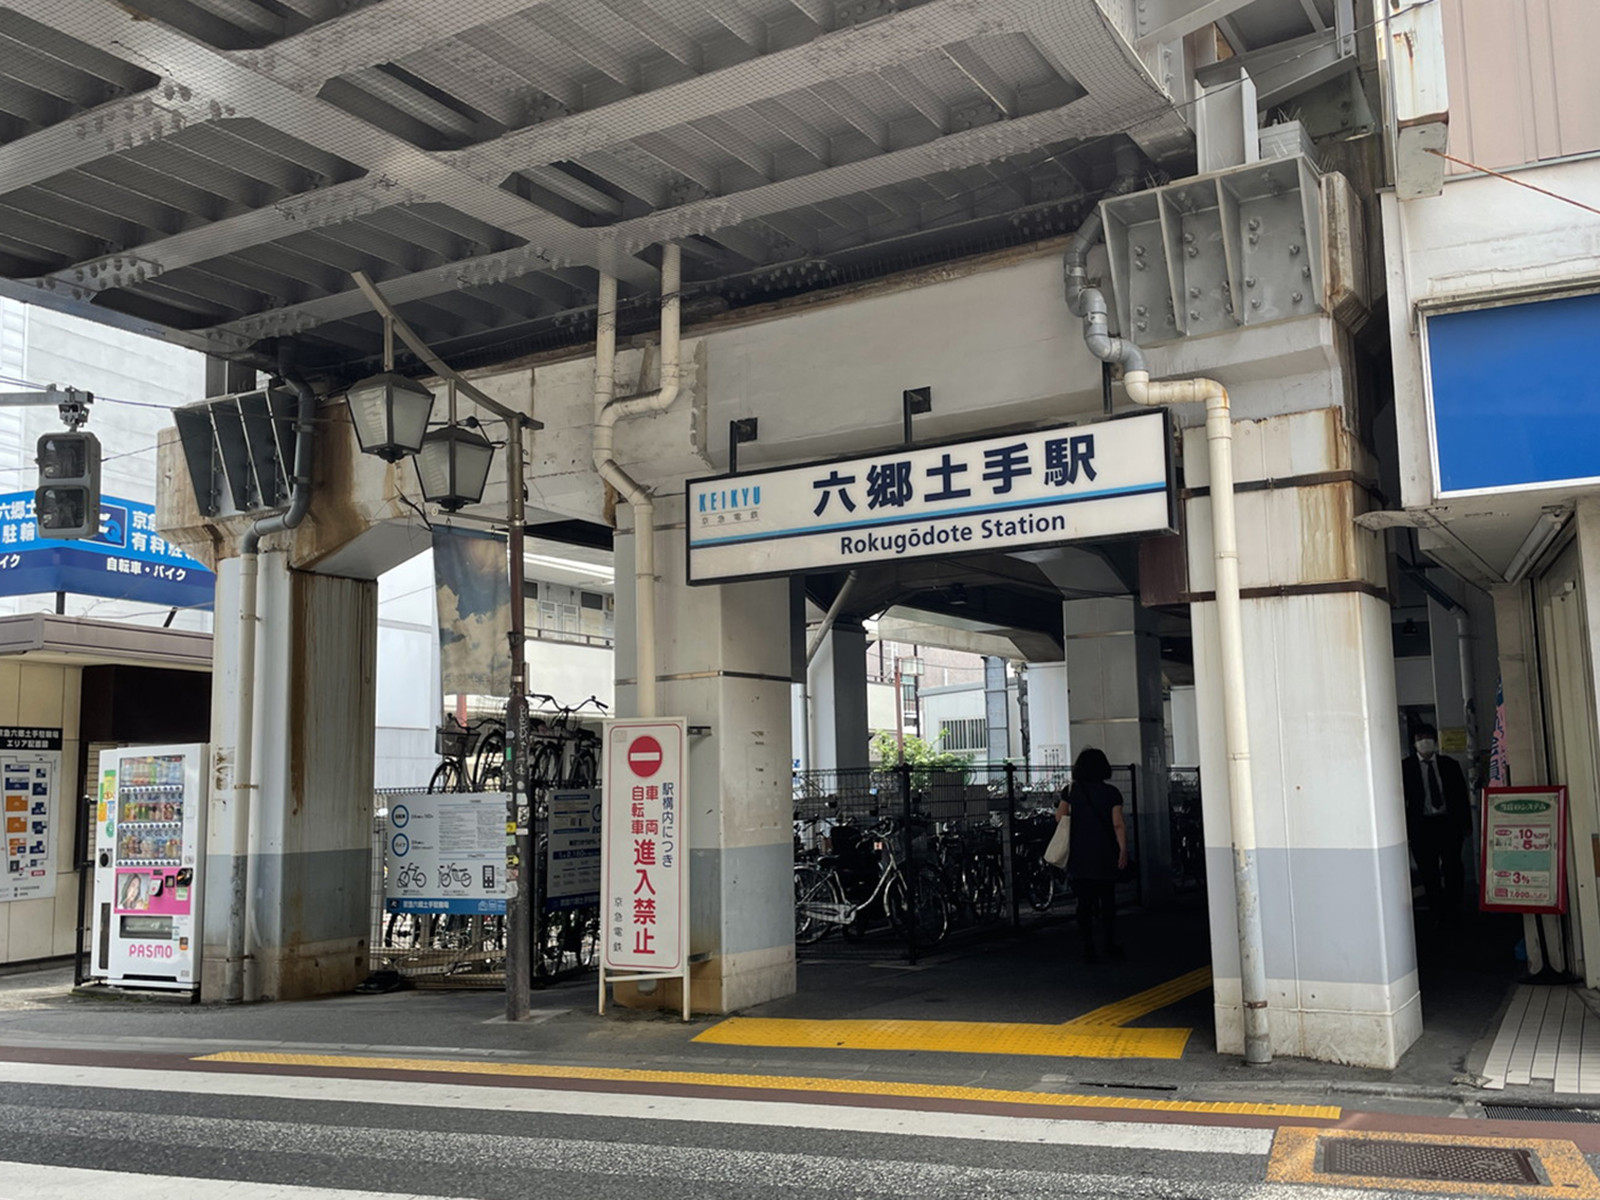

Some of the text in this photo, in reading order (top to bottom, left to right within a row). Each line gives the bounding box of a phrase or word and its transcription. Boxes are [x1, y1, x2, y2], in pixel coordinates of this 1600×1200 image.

[813, 434, 1097, 517] 六郷土手駅
[699, 486, 760, 512] KEIKYU
[841, 514, 1066, 555] Rokugōdote Station
[106, 557, 186, 581] 自転車・バイク
[662, 782, 674, 868] 駅構内につき
[633, 839, 656, 954] 進入禁止
[129, 944, 173, 958] PASMO
